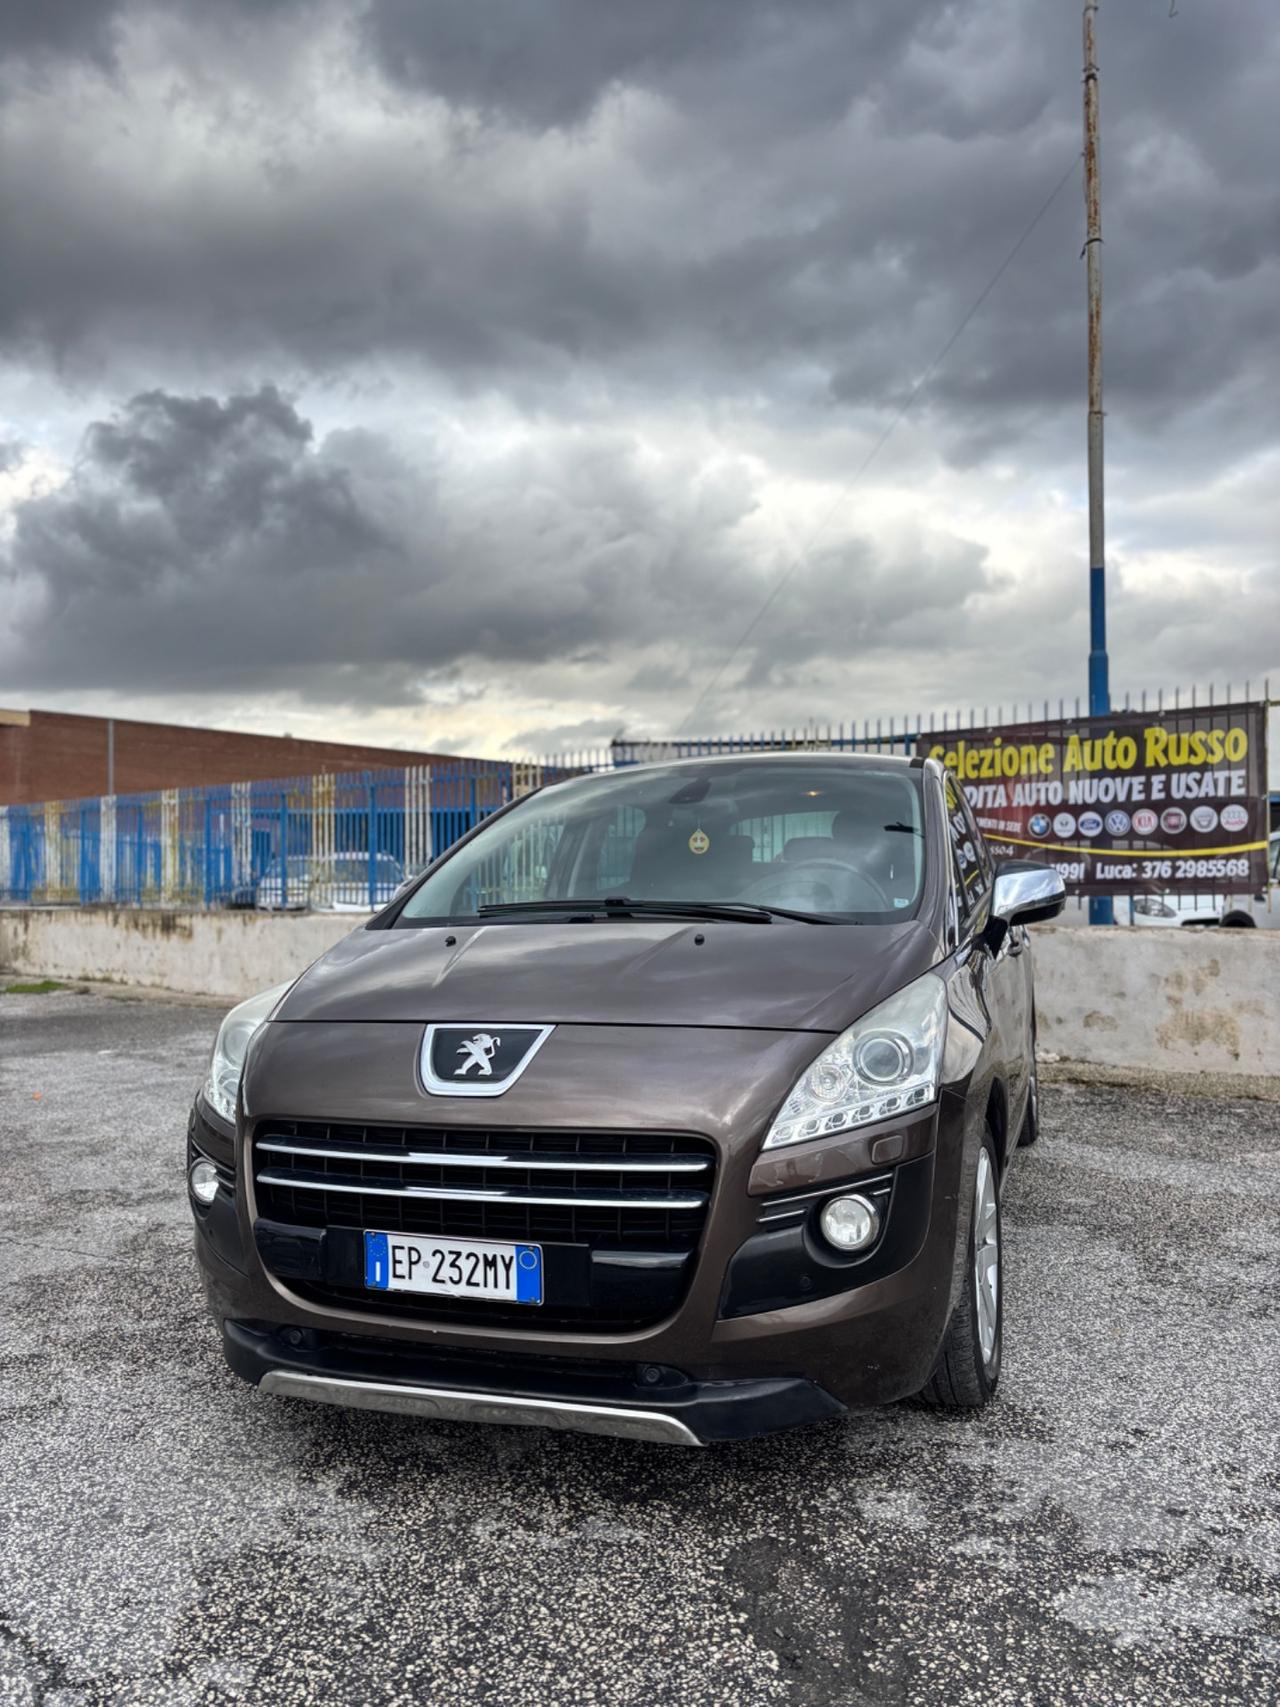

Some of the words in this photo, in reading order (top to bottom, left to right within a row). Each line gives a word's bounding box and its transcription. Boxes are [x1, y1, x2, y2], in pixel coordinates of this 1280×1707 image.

[1063, 731, 1137, 772] Auto
[1144, 727, 1248, 767] Russo
[964, 784, 1007, 808] DITA
[1012, 780, 1063, 806] AUTO
[1069, 776, 1146, 805] NUOVE
[1151, 774, 1166, 800] E
[1171, 769, 1247, 799] USATE
[1096, 862, 1137, 880] Luca:
[1142, 861, 1172, 879] 376
[1175, 859, 1249, 879] 2985568
